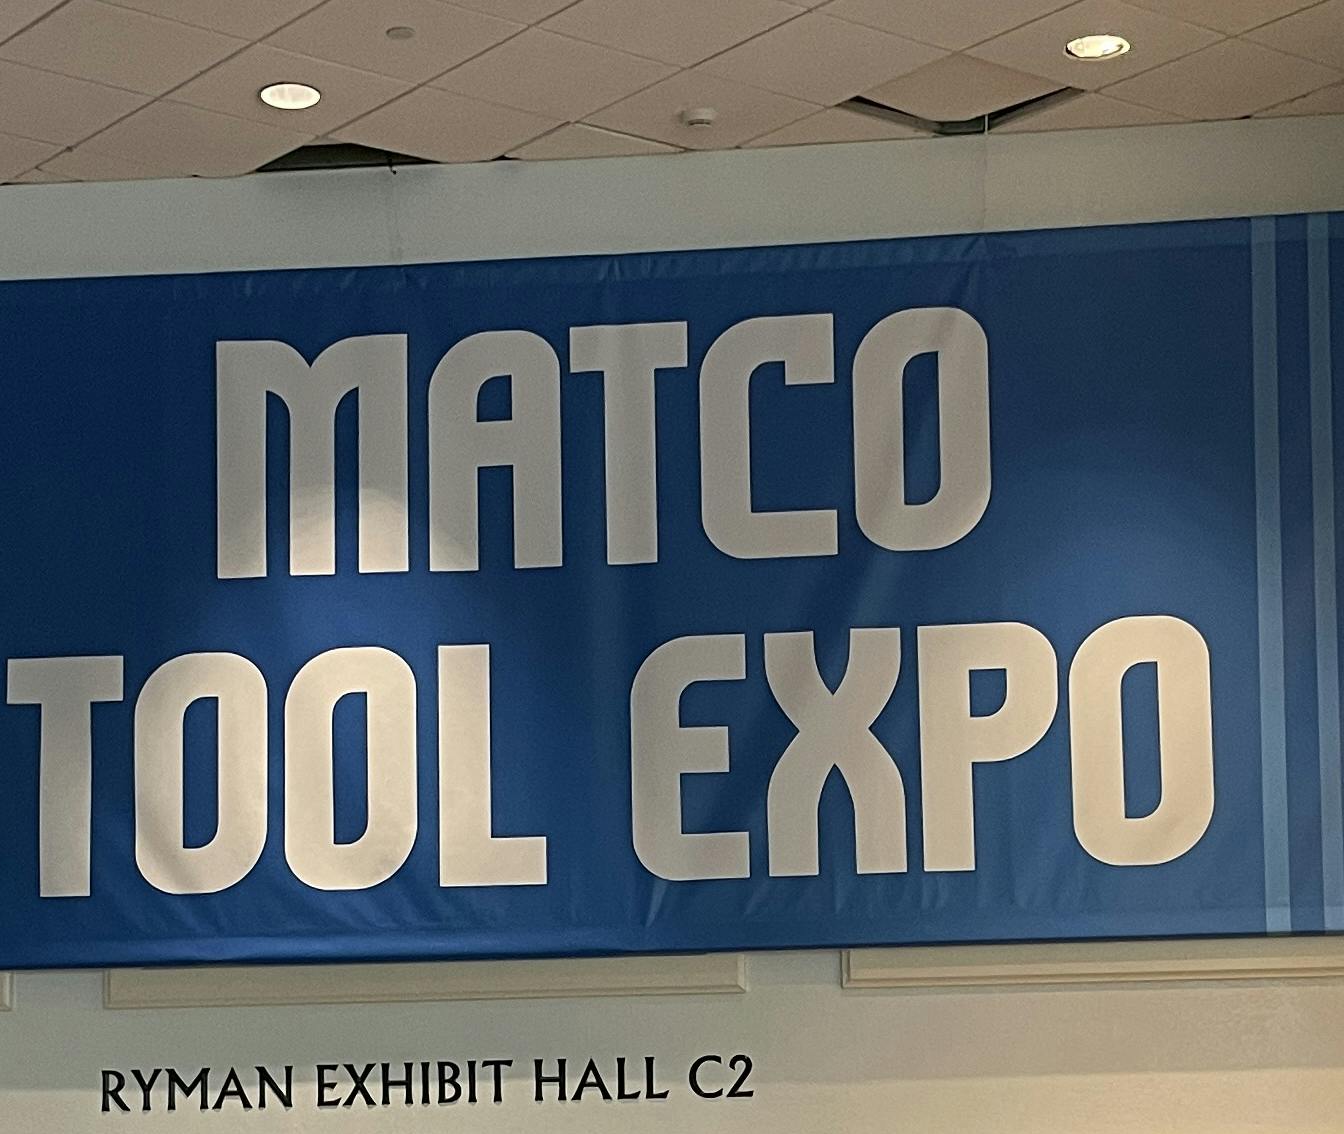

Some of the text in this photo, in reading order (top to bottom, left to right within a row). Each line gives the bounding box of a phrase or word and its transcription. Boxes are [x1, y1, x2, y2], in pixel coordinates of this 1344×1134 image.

[216, 306, 992, 579] MATCO
[6, 614, 1215, 898] TOOL EXPO
[101, 1054, 754, 1112] RYMAN EXHIBIT HALL C2
